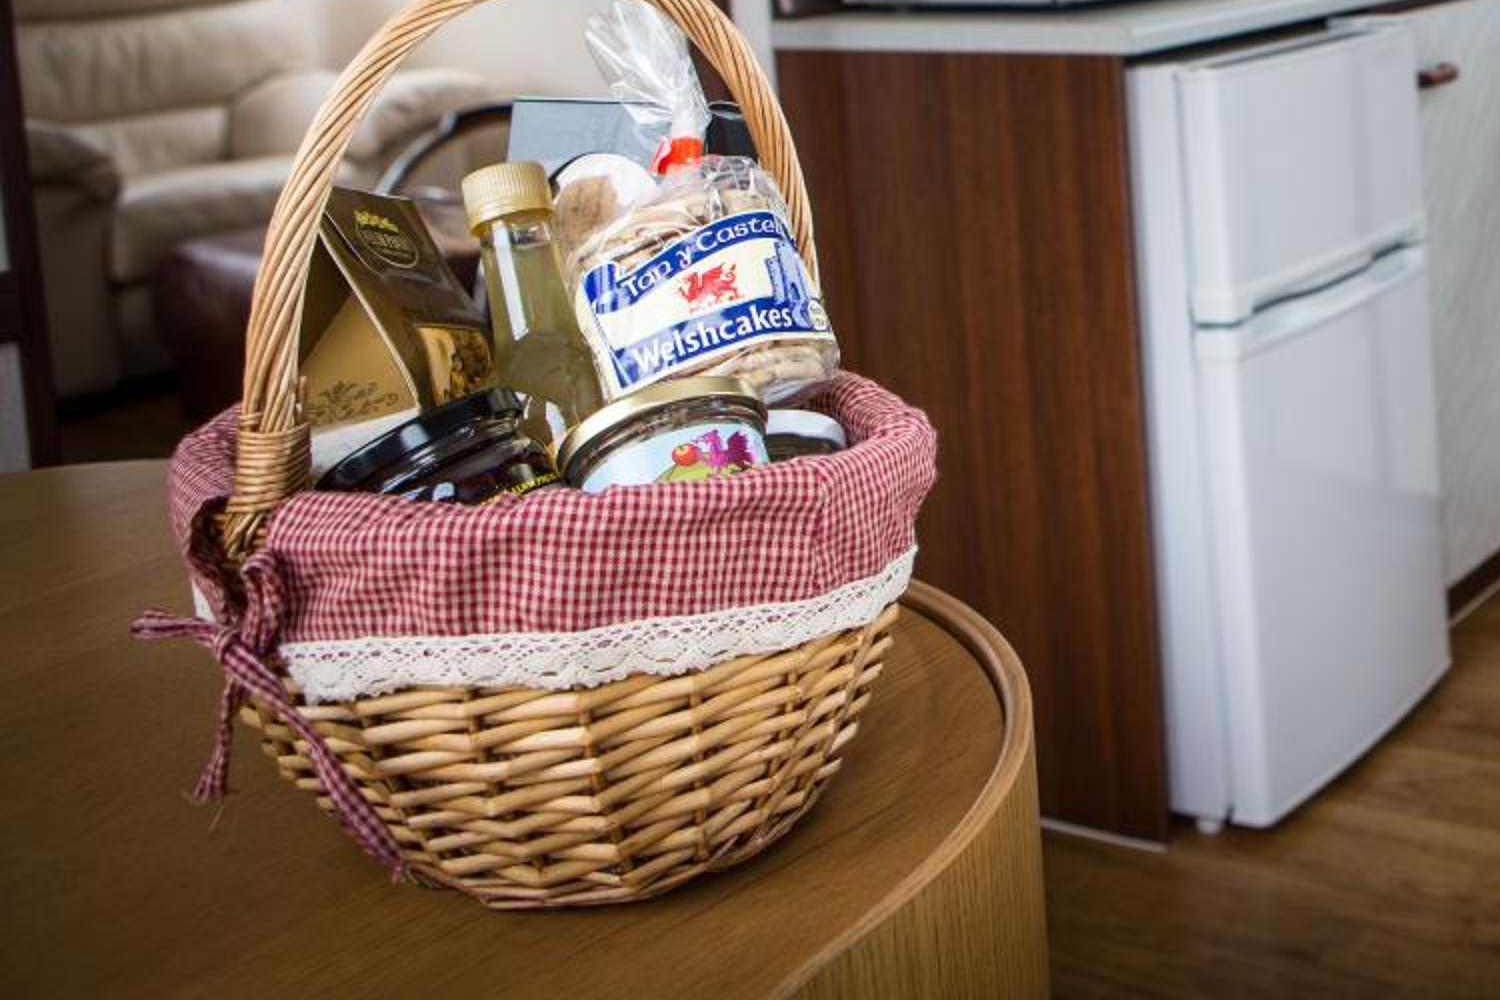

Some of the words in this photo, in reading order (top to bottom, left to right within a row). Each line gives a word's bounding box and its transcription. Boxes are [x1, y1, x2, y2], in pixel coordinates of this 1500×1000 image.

[620, 260, 674, 297] Tan
[676, 245, 692, 269] y
[633, 305, 793, 373] Welshcakes
